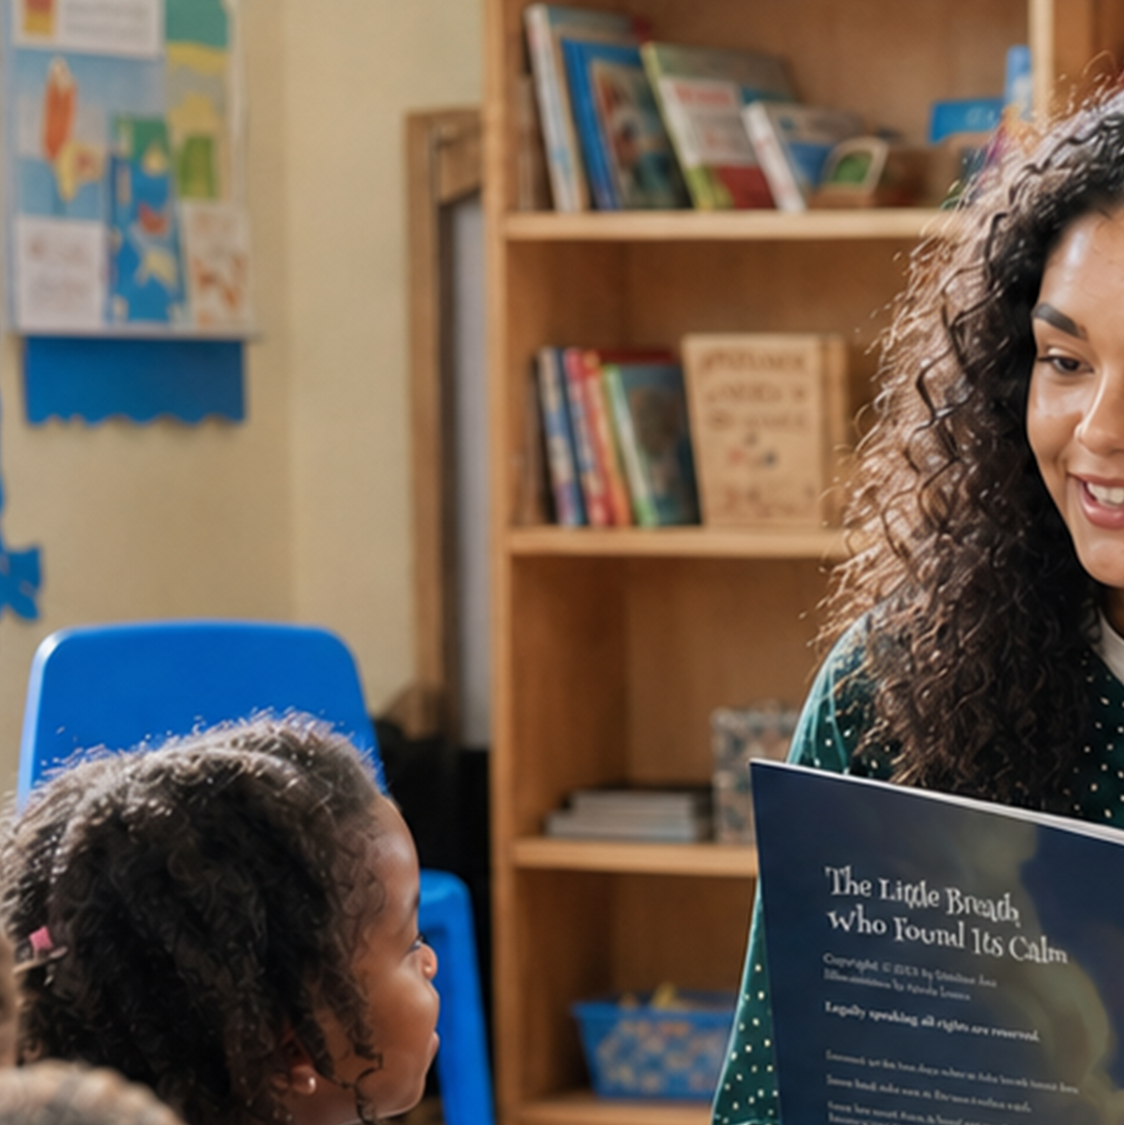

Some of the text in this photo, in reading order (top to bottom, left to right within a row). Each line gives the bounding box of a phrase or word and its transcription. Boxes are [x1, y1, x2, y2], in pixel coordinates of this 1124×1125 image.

[825, 865, 1021, 928] The Little Breath
[827, 903, 1069, 964] Who Found Its Calm
[824, 1001, 867, 1020] Legally
